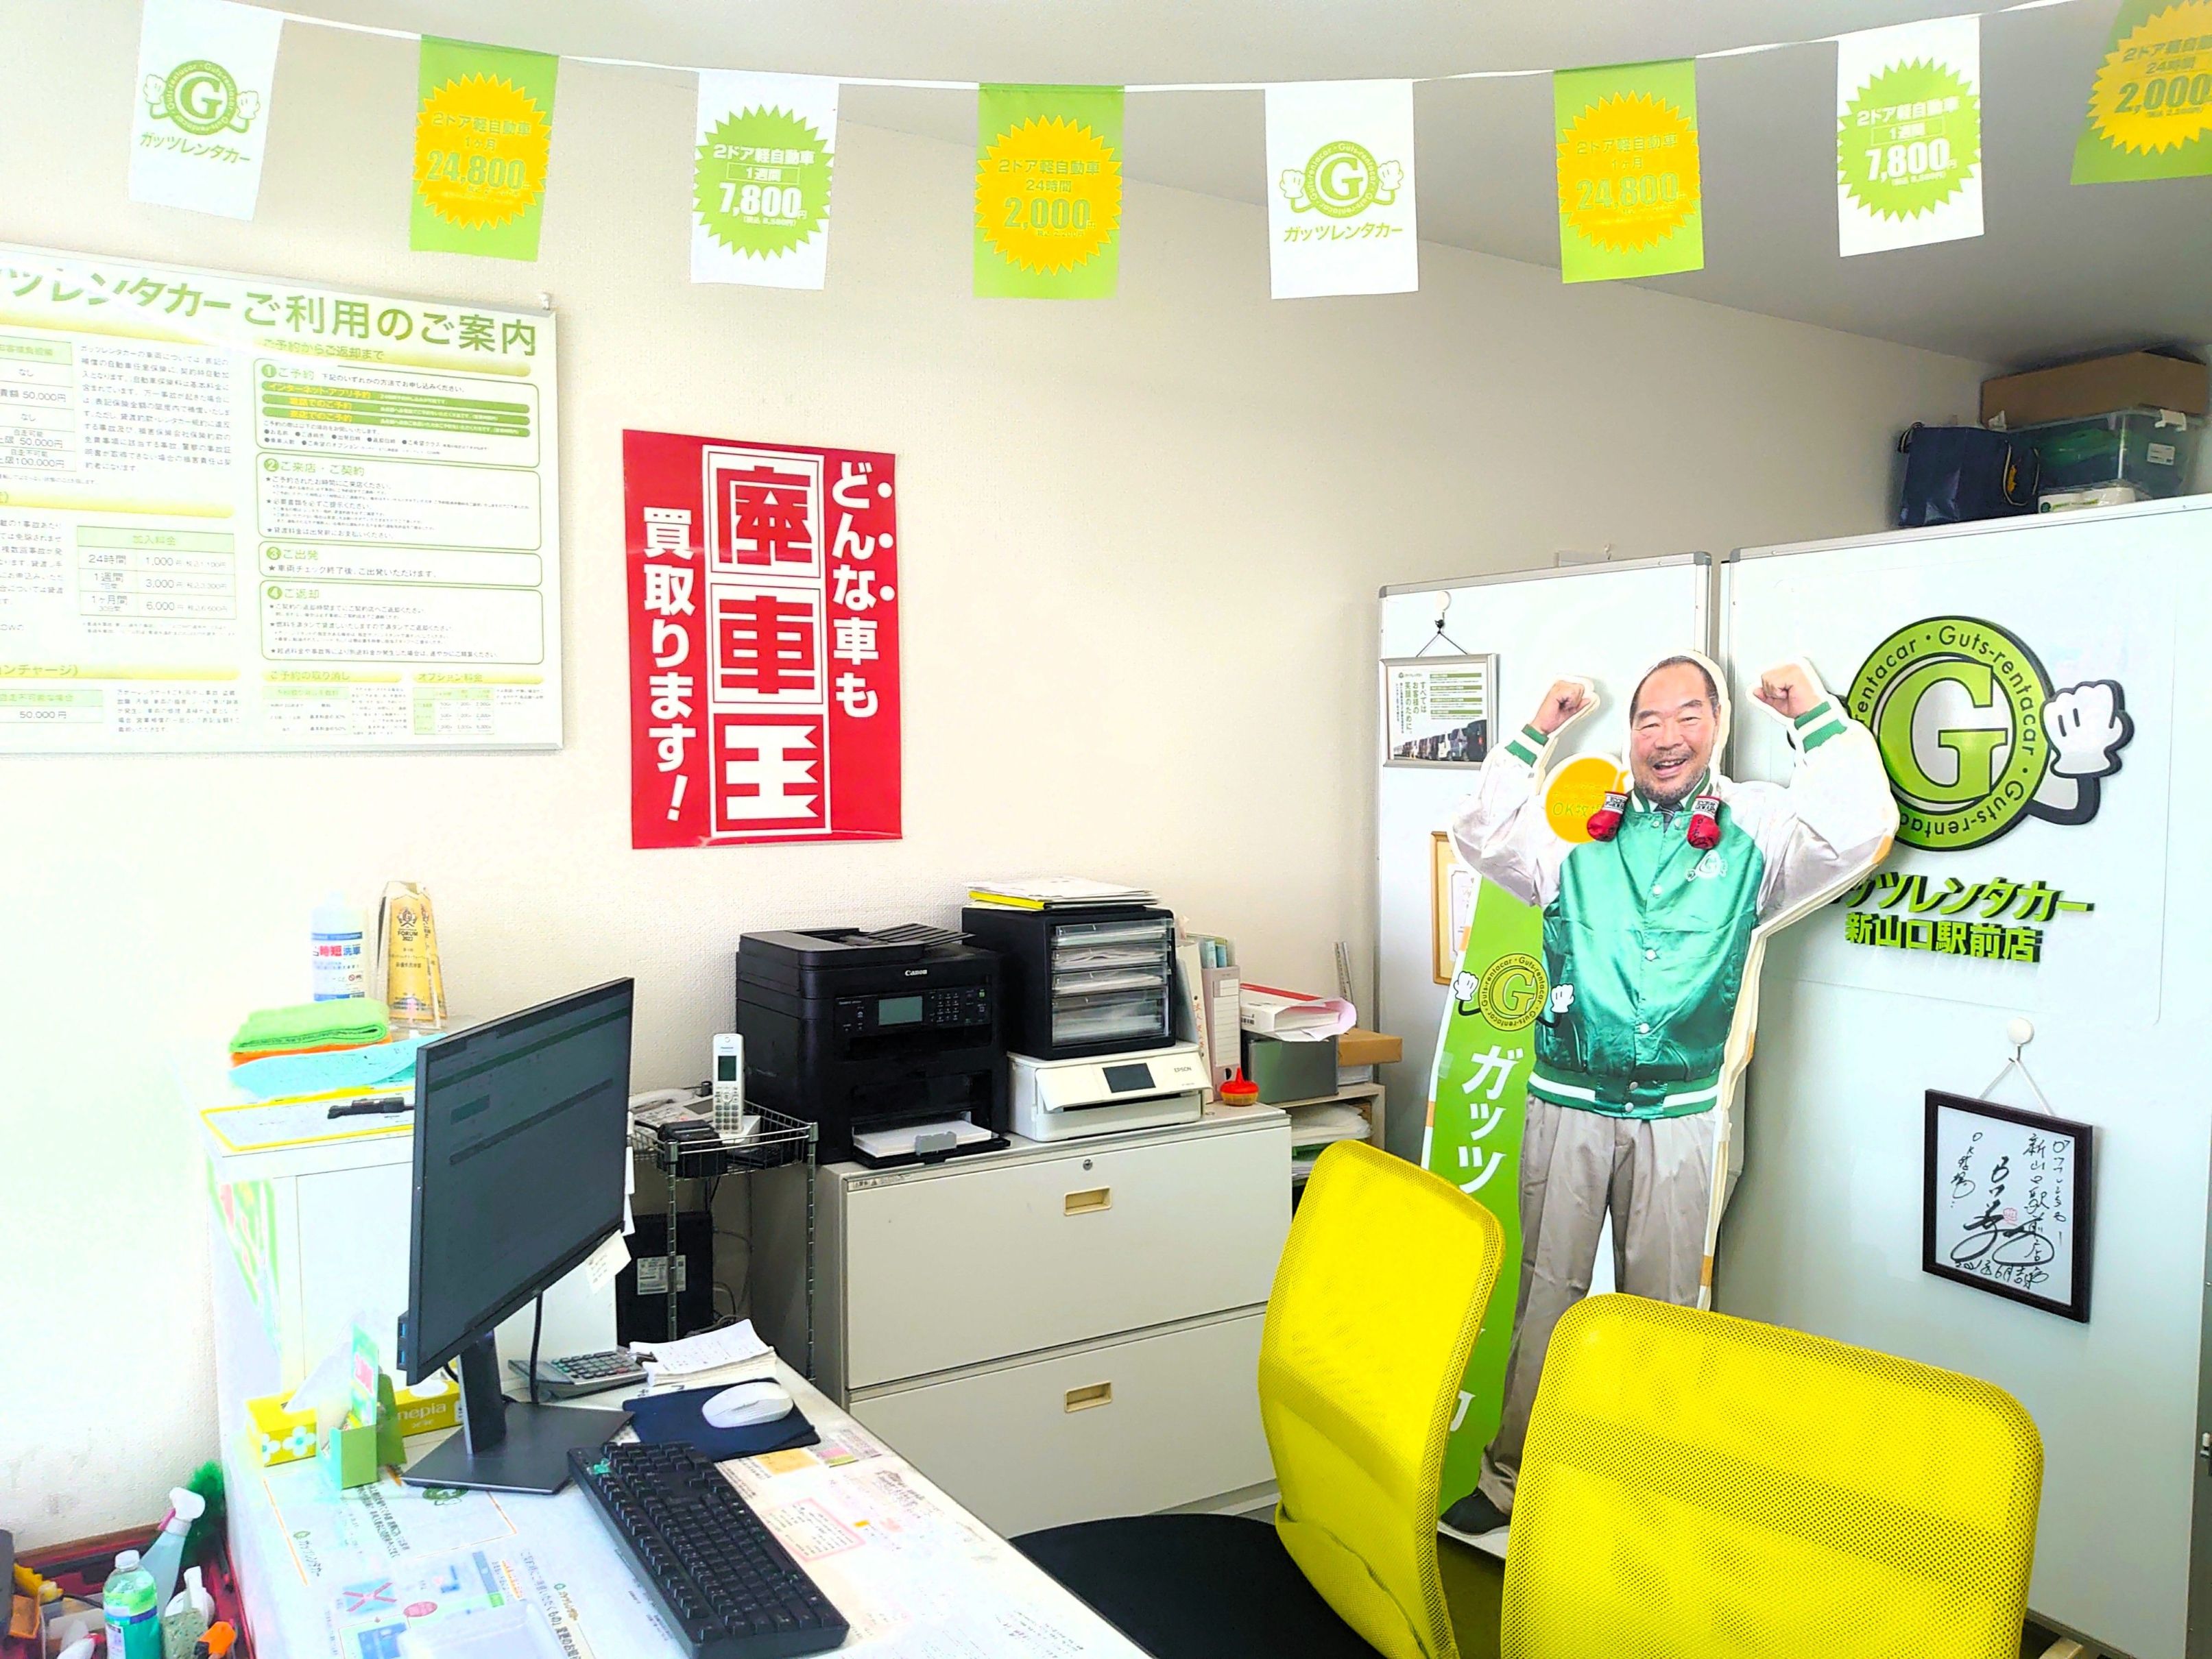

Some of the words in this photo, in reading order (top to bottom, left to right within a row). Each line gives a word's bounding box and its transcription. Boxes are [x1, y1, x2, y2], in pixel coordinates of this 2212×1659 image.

[180, 76, 223, 119] G
[2115, 73, 2212, 114] 2,000
[433, 112, 531, 136] 2ドア軽自動車
[140, 132, 251, 163] ガッツレンタカー
[713, 144, 815, 165] 2ドア軽自動車
[1577, 133, 1677, 155] 2ドア軽自動車
[998, 159, 1101, 175] 2ドア軽自動車
[1320, 157, 1364, 201] G
[1026, 179, 1072, 193] 24時間
[1284, 222, 1403, 242] ガッツレンタカー
[0, 268, 232, 317] ツレンタカー
[243, 291, 537, 356] ご利用のご案内
[88, 553, 127, 566] 24時間
[831, 461, 880, 718] どんな車も
[714, 465, 820, 821] 廃車王
[0, 664, 79, 677] ンチャージ)
[1938, 625, 2037, 757] Guts-rentacar
[1879, 659, 2009, 804] G
[1844, 871, 2095, 922] ッツレンタカー
[1844, 911, 2043, 963] 新山口駅前店
[904, 969, 928, 977] Canon
[1491, 967, 1535, 1017] G
[397, 1403, 447, 1421] nepia
